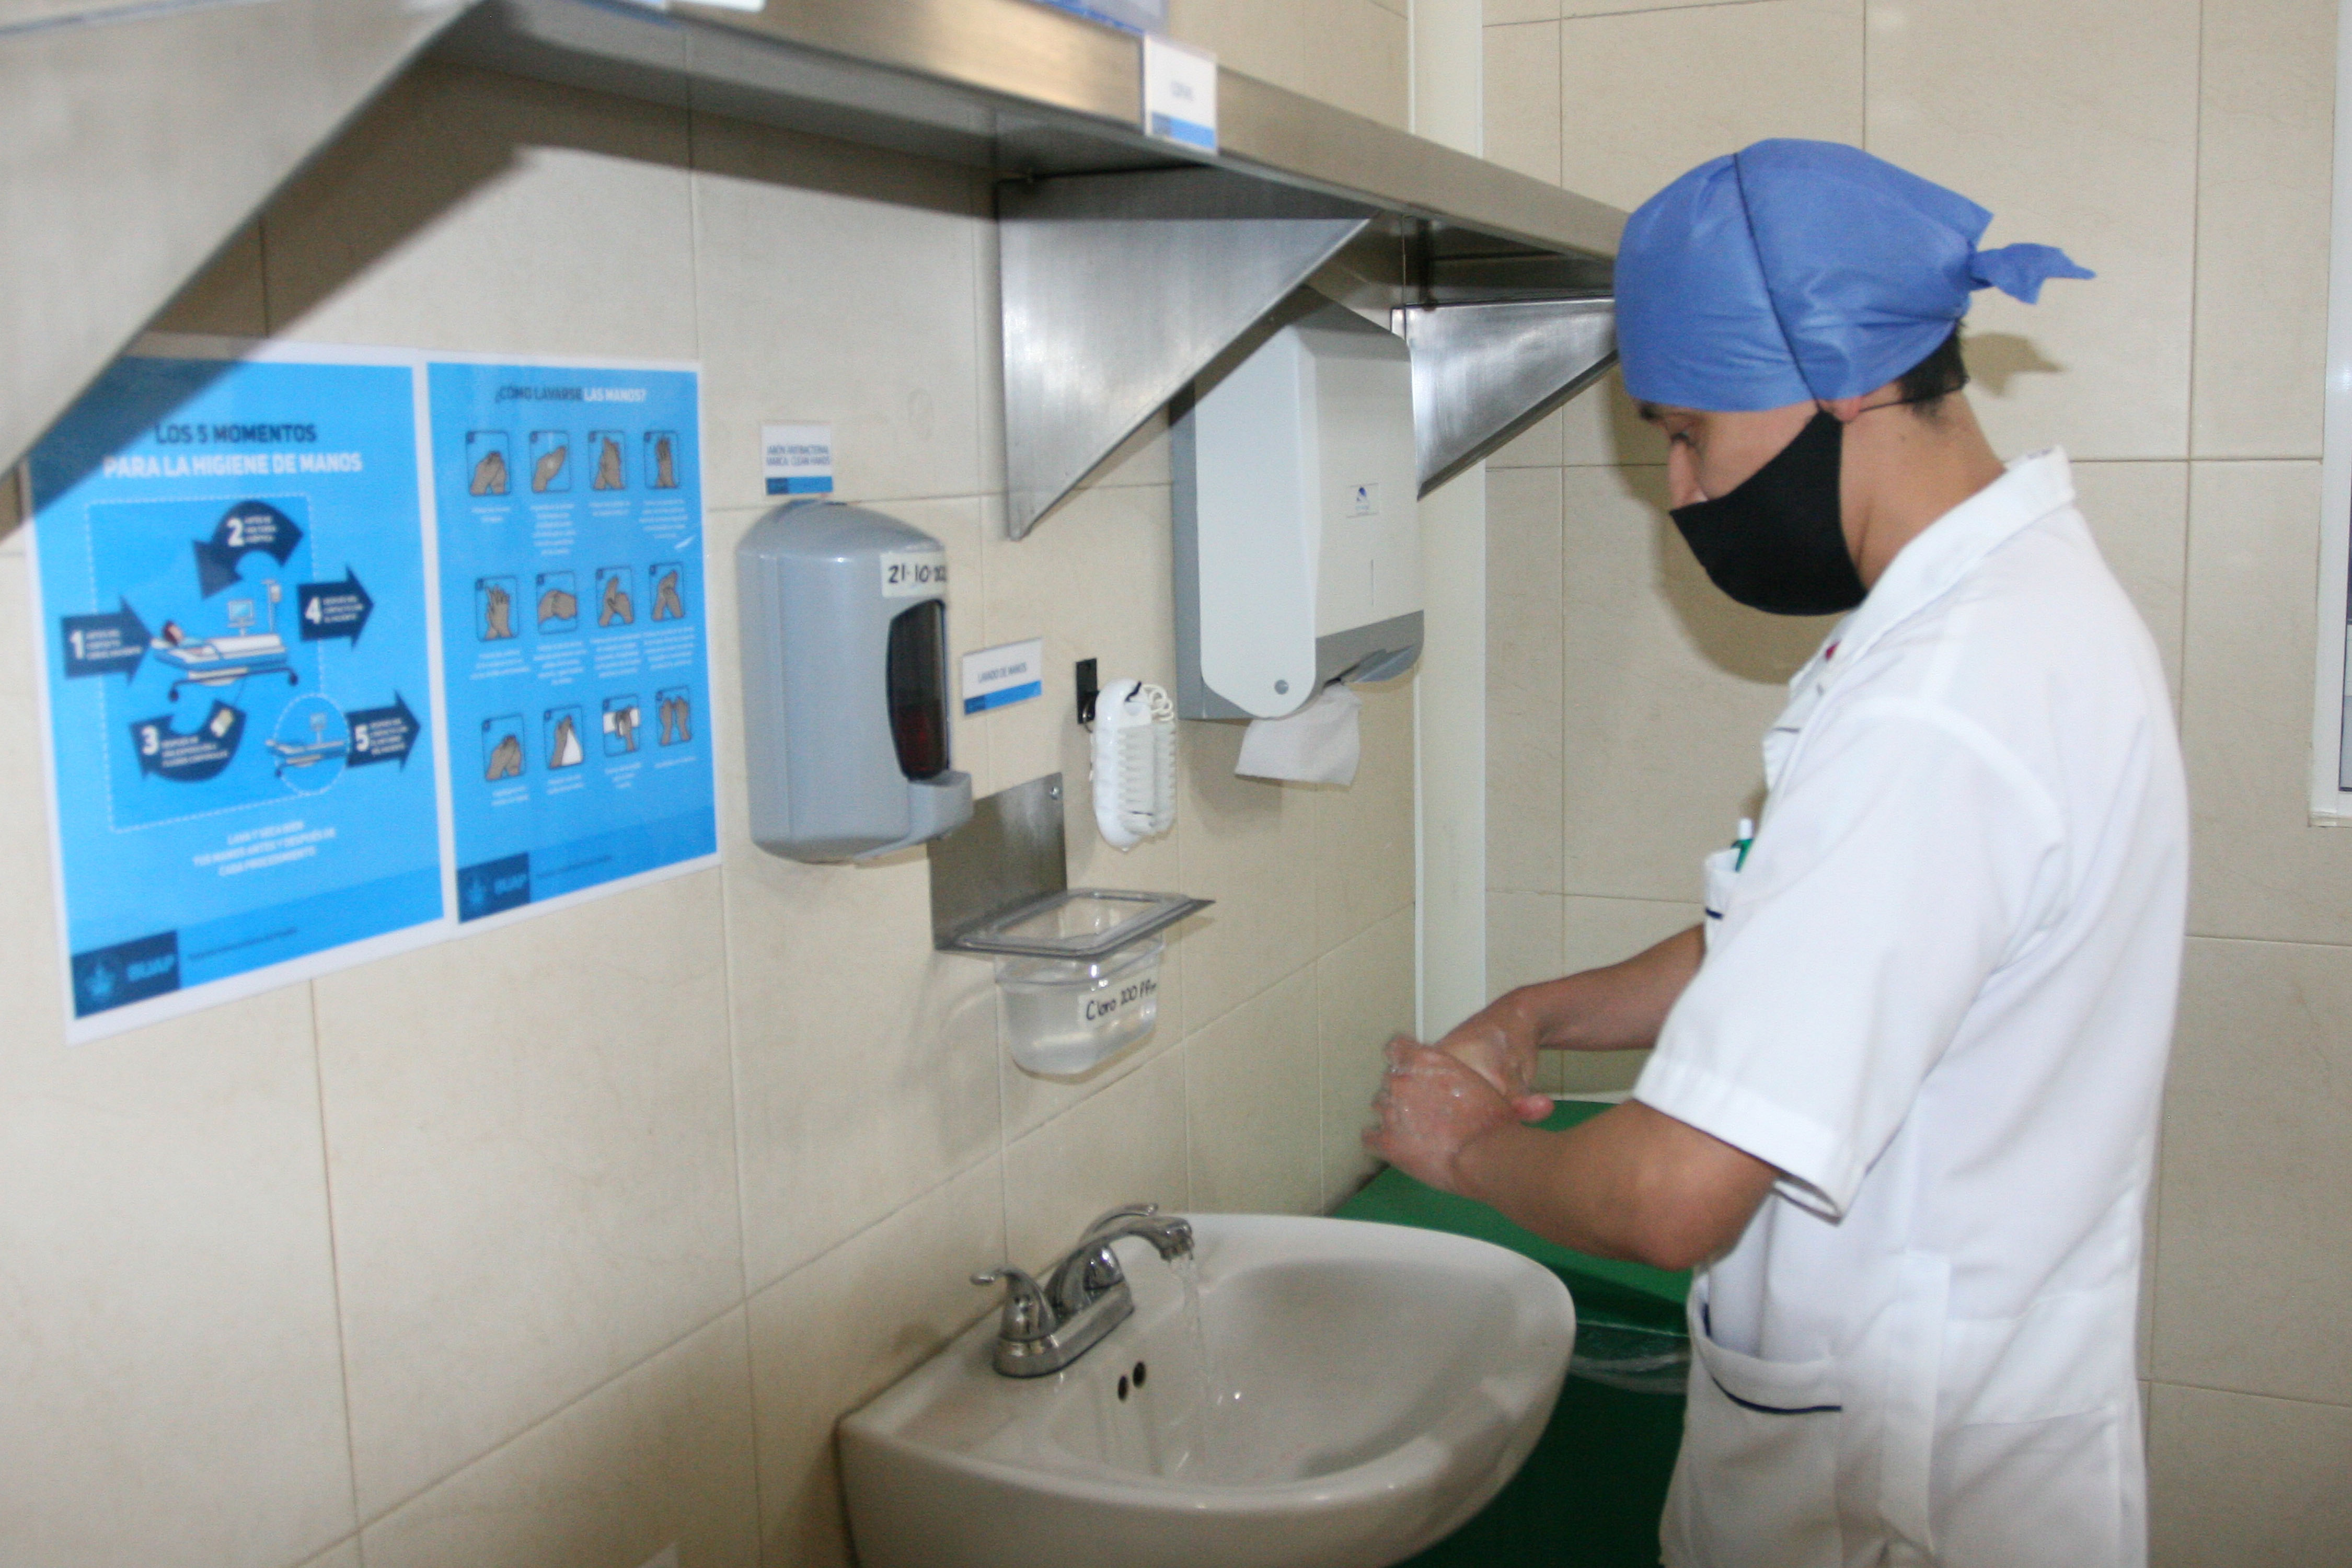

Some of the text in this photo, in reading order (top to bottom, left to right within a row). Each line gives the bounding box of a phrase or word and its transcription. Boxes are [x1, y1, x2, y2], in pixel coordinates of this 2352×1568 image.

[584, 387, 604, 401] LAS
[157, 423, 317, 444] LOS 5 MOMENTOS
[102, 452, 363, 478] PARA LA HIGIENE DE MANOS
[227, 517, 244, 547] 2
[305, 596, 321, 624] 4
[70, 630, 84, 660] 1
[142, 725, 158, 755] 3
[355, 724, 369, 752] 5
